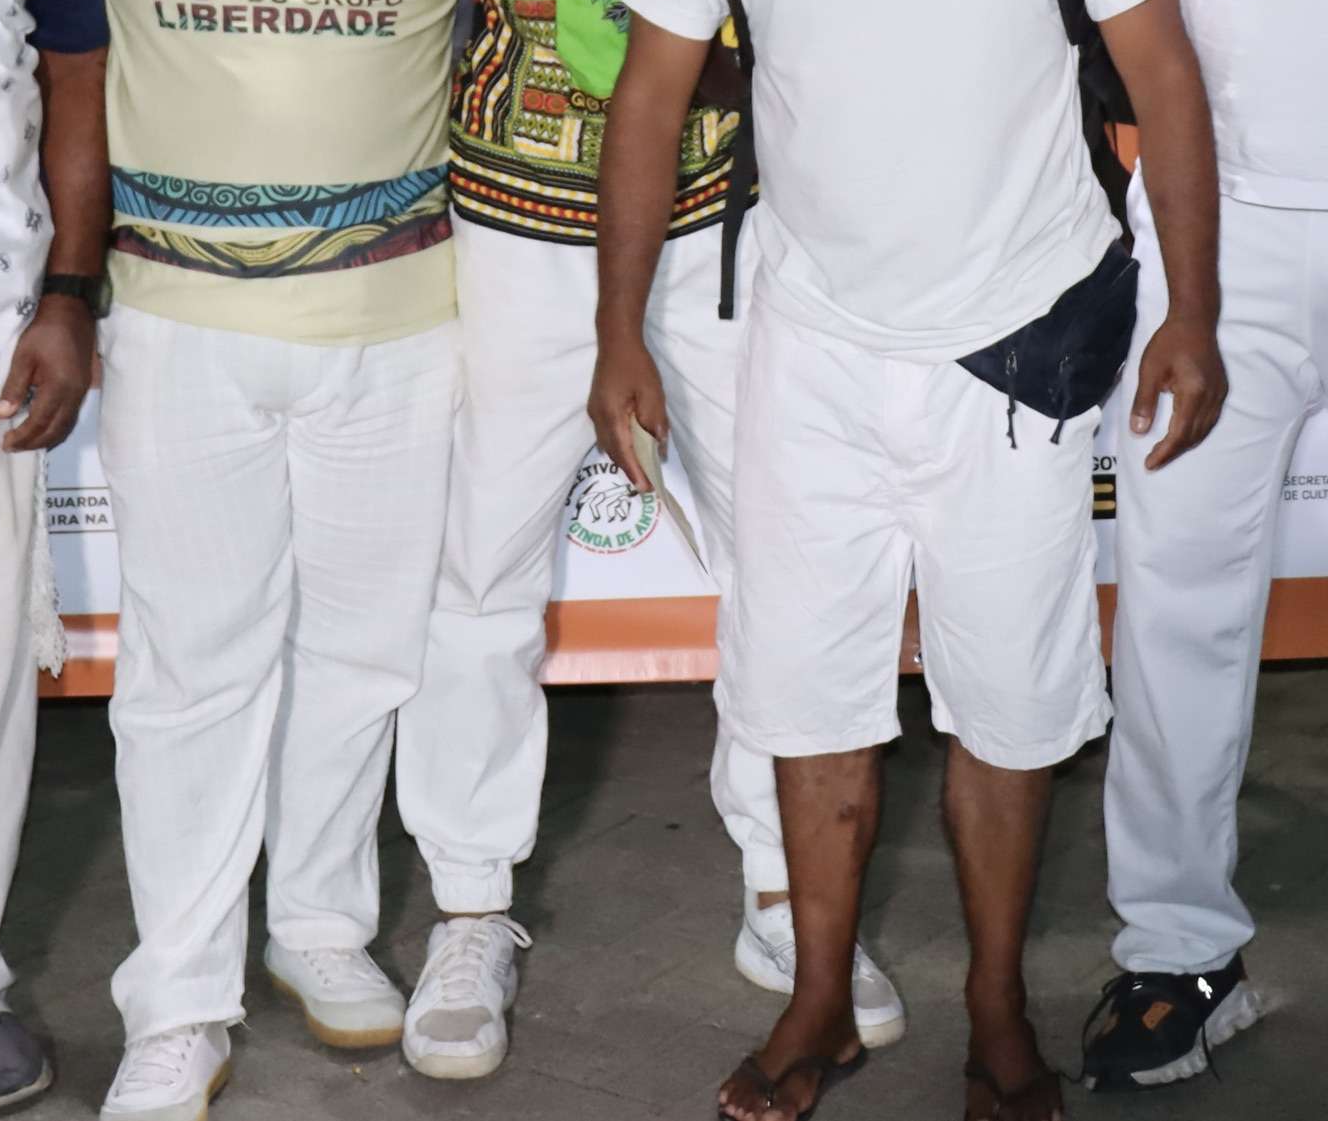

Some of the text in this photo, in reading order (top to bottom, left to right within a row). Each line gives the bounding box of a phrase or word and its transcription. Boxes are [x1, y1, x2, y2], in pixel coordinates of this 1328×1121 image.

[153, 0, 399, 38] LIBERDADE
[1284, 490, 1299, 501] DE
[48, 513, 109, 526] IRA NA
